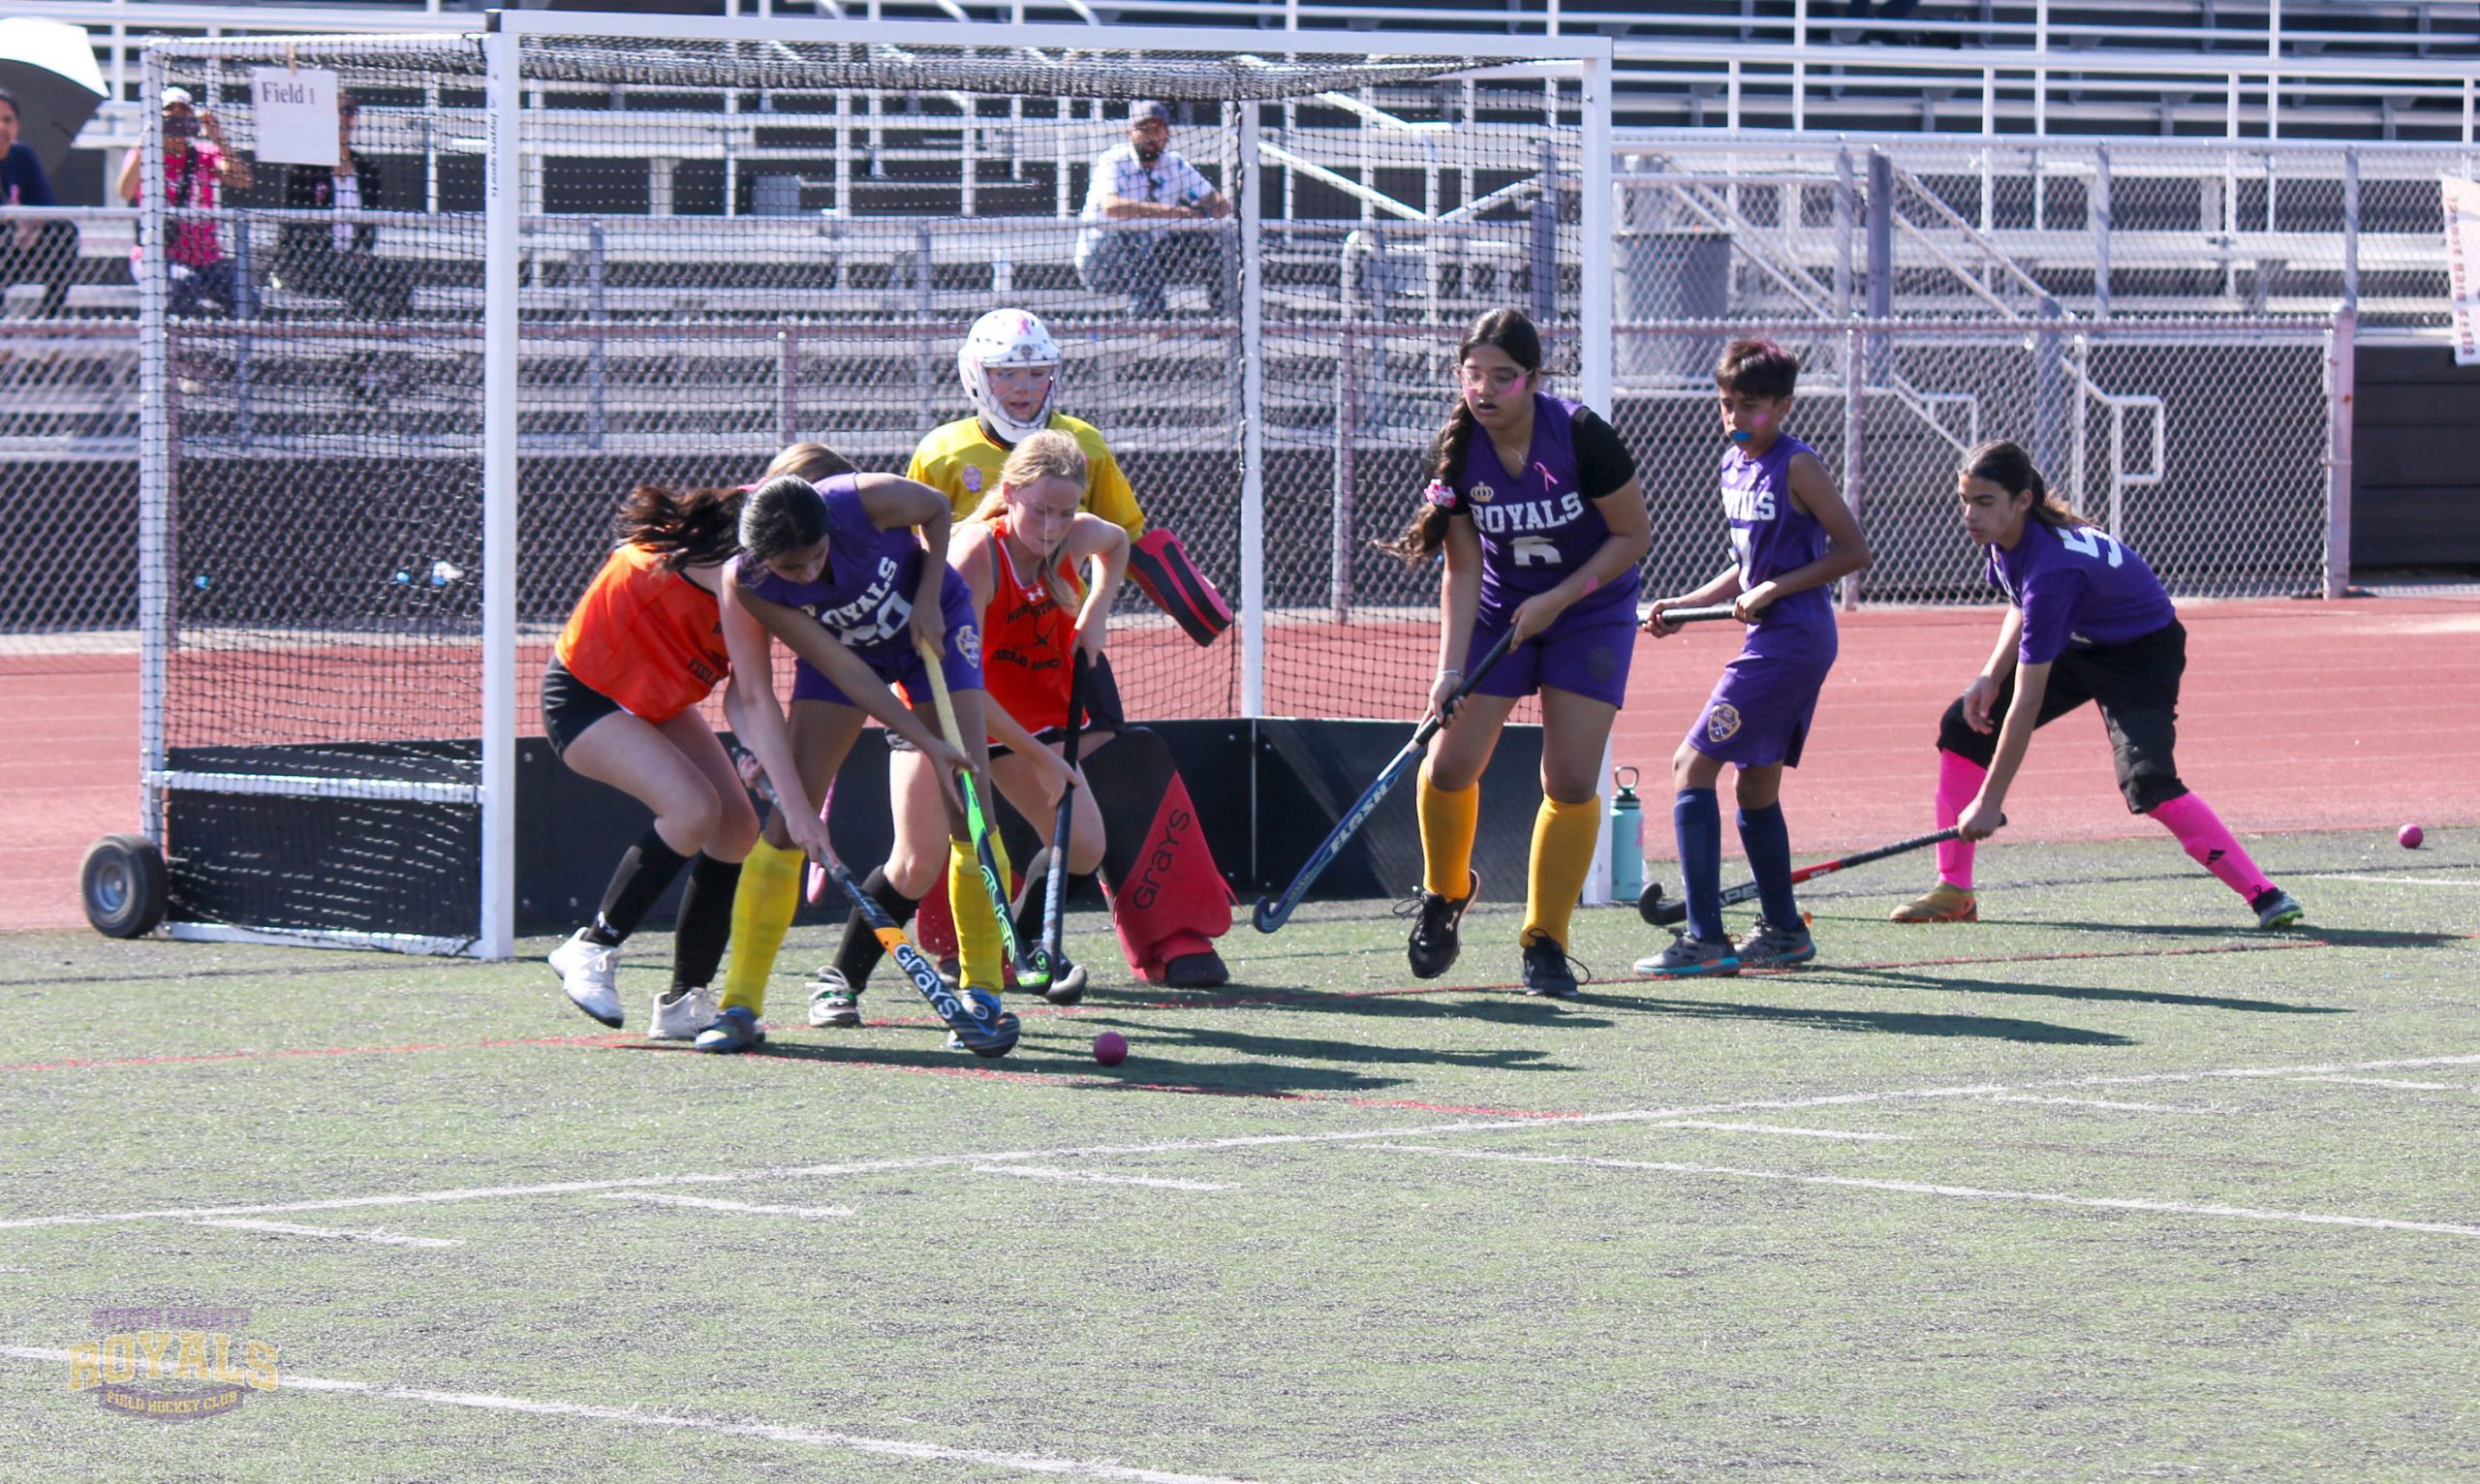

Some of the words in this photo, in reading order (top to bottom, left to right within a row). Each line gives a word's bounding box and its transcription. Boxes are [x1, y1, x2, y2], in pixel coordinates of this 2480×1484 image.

[262, 81, 304, 104] Field
[1468, 491, 1585, 533] ROYALS
[2056, 526, 2124, 569] 5
[821, 556, 898, 628] OYALS
